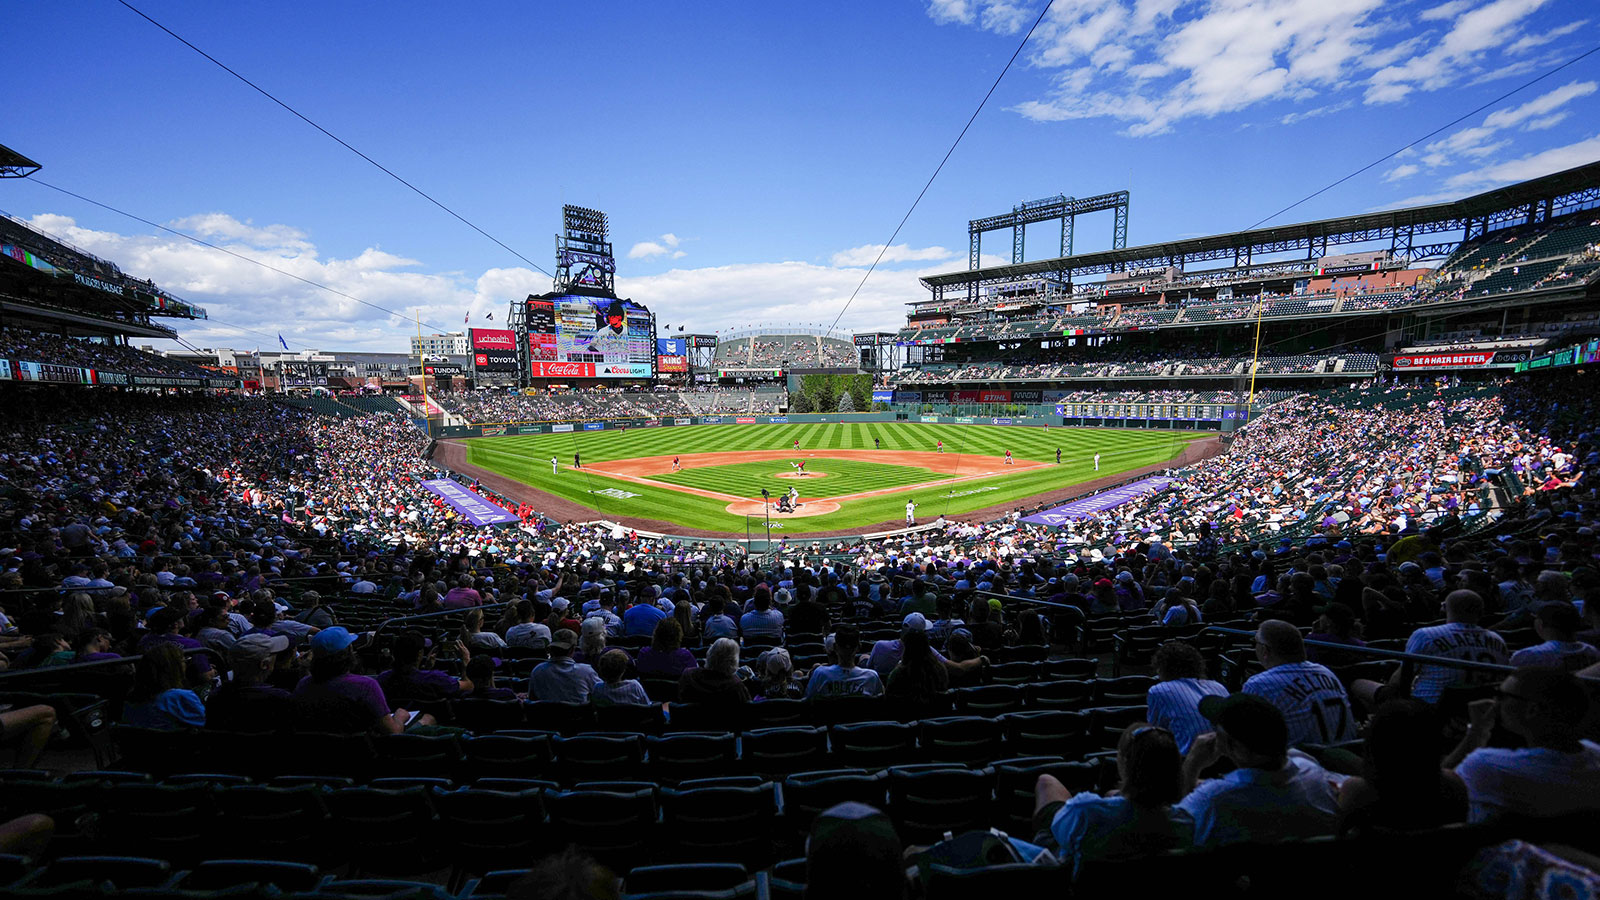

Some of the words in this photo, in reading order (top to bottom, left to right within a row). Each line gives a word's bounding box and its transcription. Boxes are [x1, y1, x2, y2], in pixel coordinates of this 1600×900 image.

[479, 334, 510, 343] uchealth
[489, 356, 517, 364] TOYOTA
[663, 356, 682, 365] KING
[1413, 357, 1424, 365] BE
[1430, 356, 1452, 365] HAIR
[1452, 354, 1486, 363] BETTER
[610, 365, 629, 374] Coors
[1283, 672, 1346, 700] HELTON
[1311, 697, 1348, 742] 17
